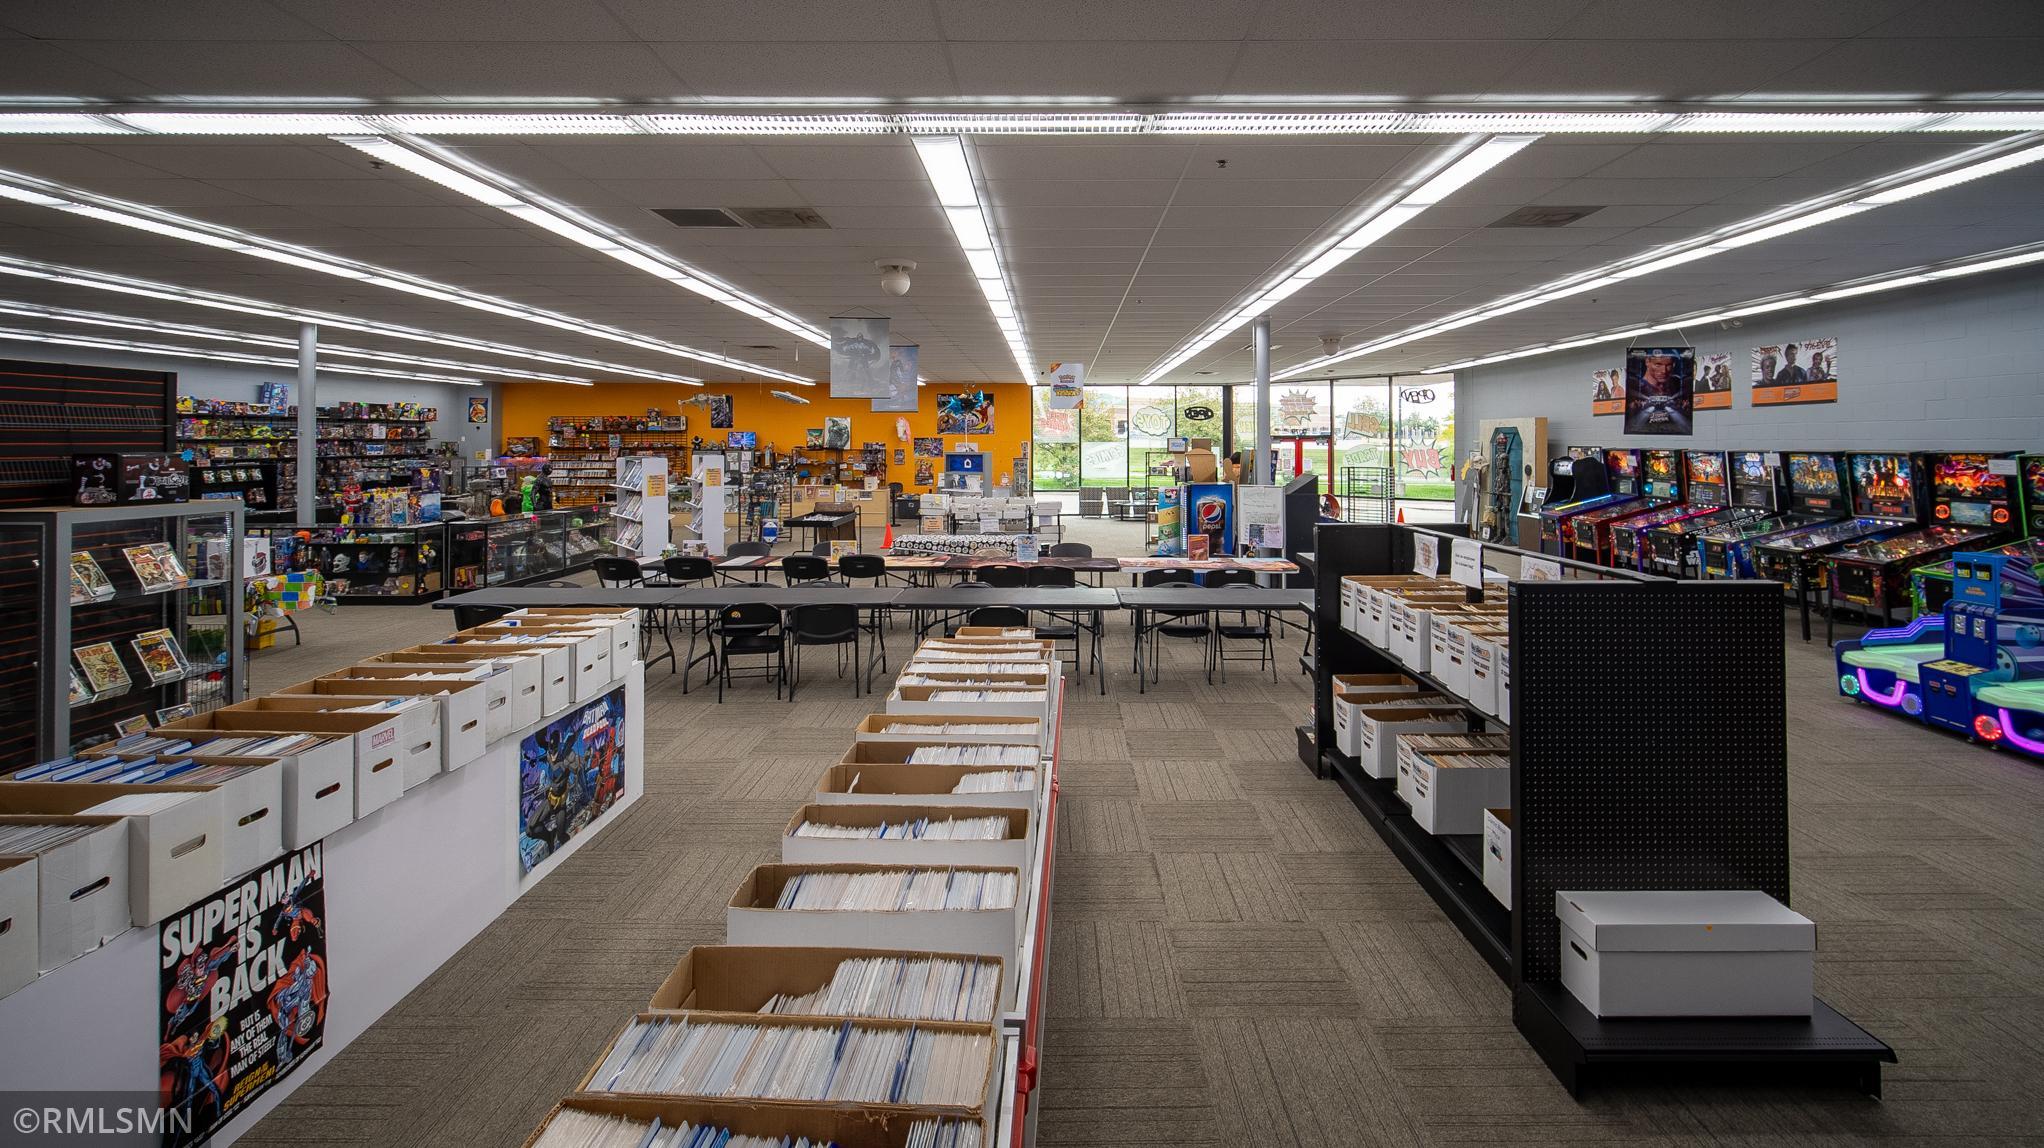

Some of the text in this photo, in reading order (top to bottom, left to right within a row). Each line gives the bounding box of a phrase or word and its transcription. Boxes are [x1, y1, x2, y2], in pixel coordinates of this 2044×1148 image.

[372, 727, 395, 750] MARVEL
[162, 842, 322, 969] SUPERMAN
[237, 914, 262, 965] IS
[210, 936, 288, 1023] BACK
[230, 1013, 273, 1053] ANY OF THEM
[240, 1014, 254, 1032] BUT
[230, 1058, 248, 1079] MAN
[248, 1051, 258, 1065] OF
[257, 1035, 277, 1058] STEEL?
[239, 1030, 269, 1059] THE REAL
